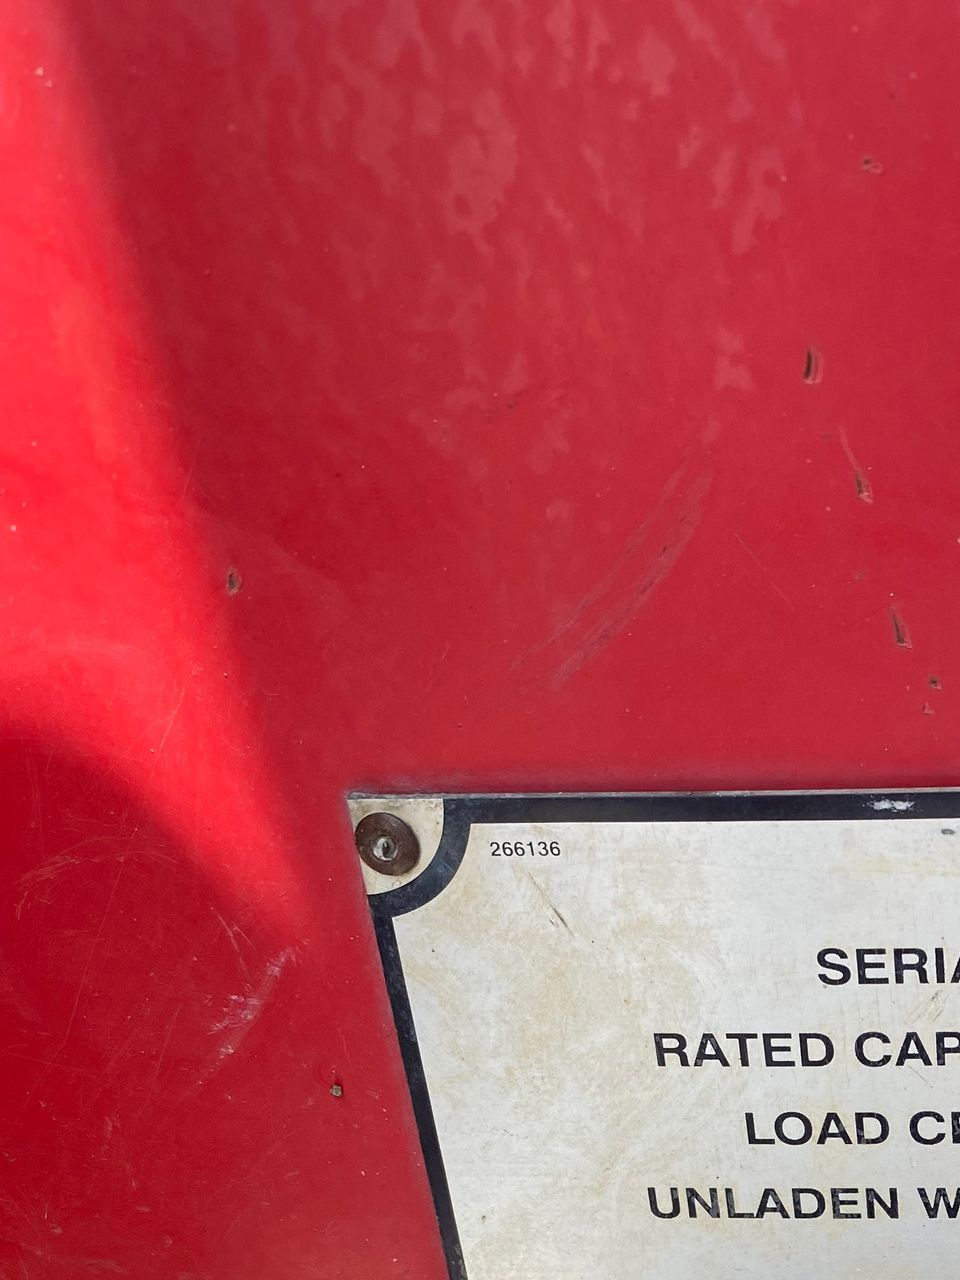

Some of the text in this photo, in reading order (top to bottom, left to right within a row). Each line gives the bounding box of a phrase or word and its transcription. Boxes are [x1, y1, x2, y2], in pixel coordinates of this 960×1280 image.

[490, 842, 561, 856] 266136
[653, 1032, 834, 1067] RATED
[745, 1112, 889, 1145] LOAD
[646, 1187, 899, 1219] UNLADEN
